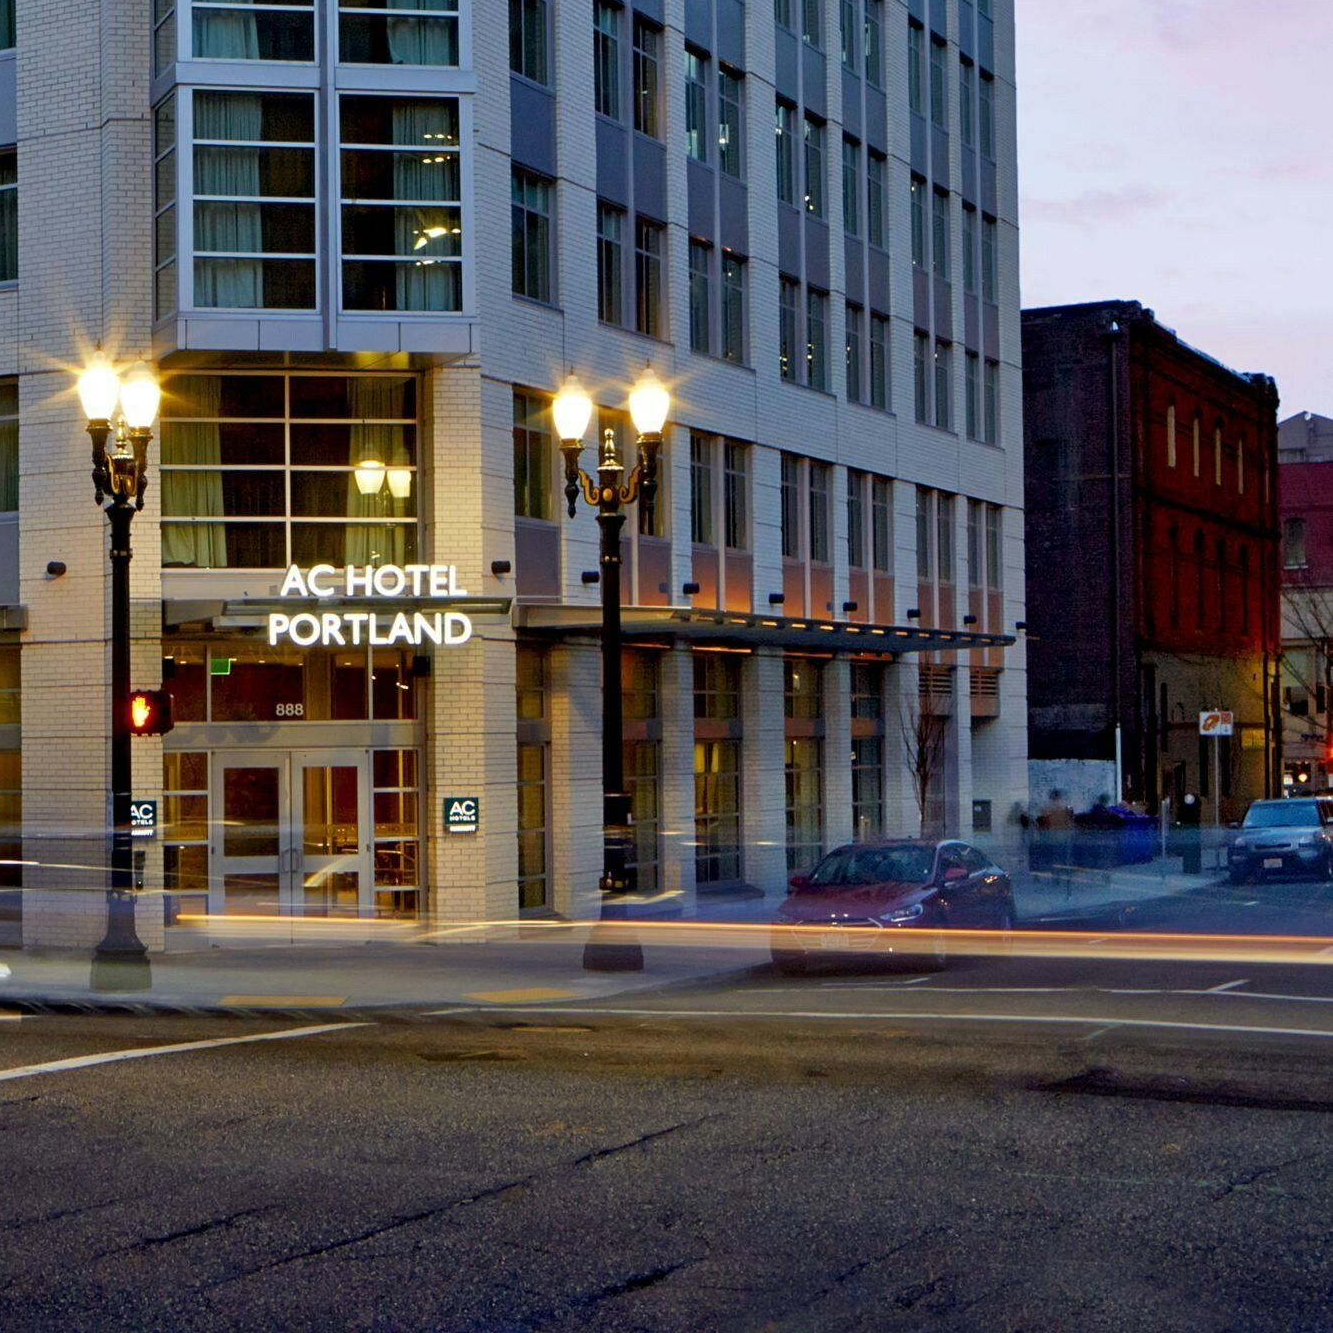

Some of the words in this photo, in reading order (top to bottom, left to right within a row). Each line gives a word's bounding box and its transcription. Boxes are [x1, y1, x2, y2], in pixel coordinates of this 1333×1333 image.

[280, 564, 335, 597] AC
[346, 564, 467, 597] HOTEL
[269, 612, 472, 646] PORTLAND
[276, 703, 304, 716] 888
[130, 804, 153, 819] AC
[449, 800, 476, 816] AC
[449, 814, 476, 822] HOTELS
